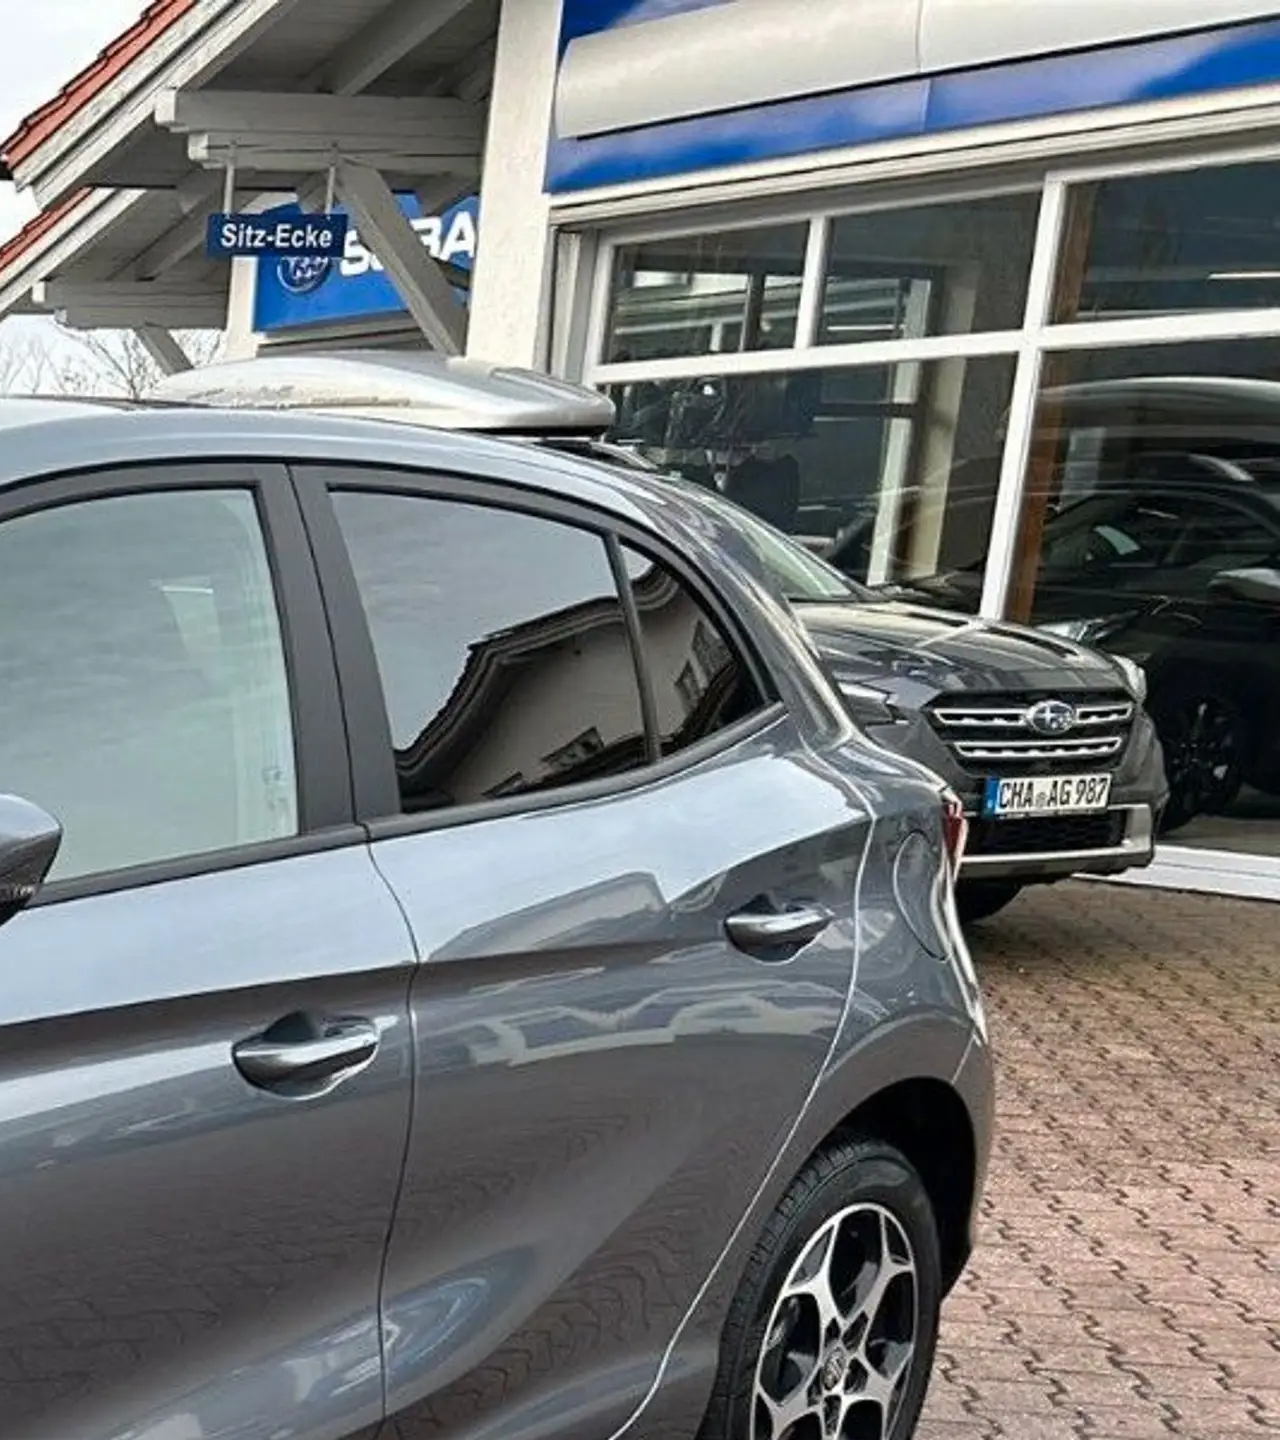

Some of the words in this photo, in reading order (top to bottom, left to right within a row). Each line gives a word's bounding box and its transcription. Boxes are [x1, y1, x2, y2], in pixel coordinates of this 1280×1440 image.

[221, 222, 333, 249] Sitz-Ecke
[1000, 781, 1034, 809] CHA
[1048, 779, 1072, 808] AG
[1076, 777, 1109, 805] 987
